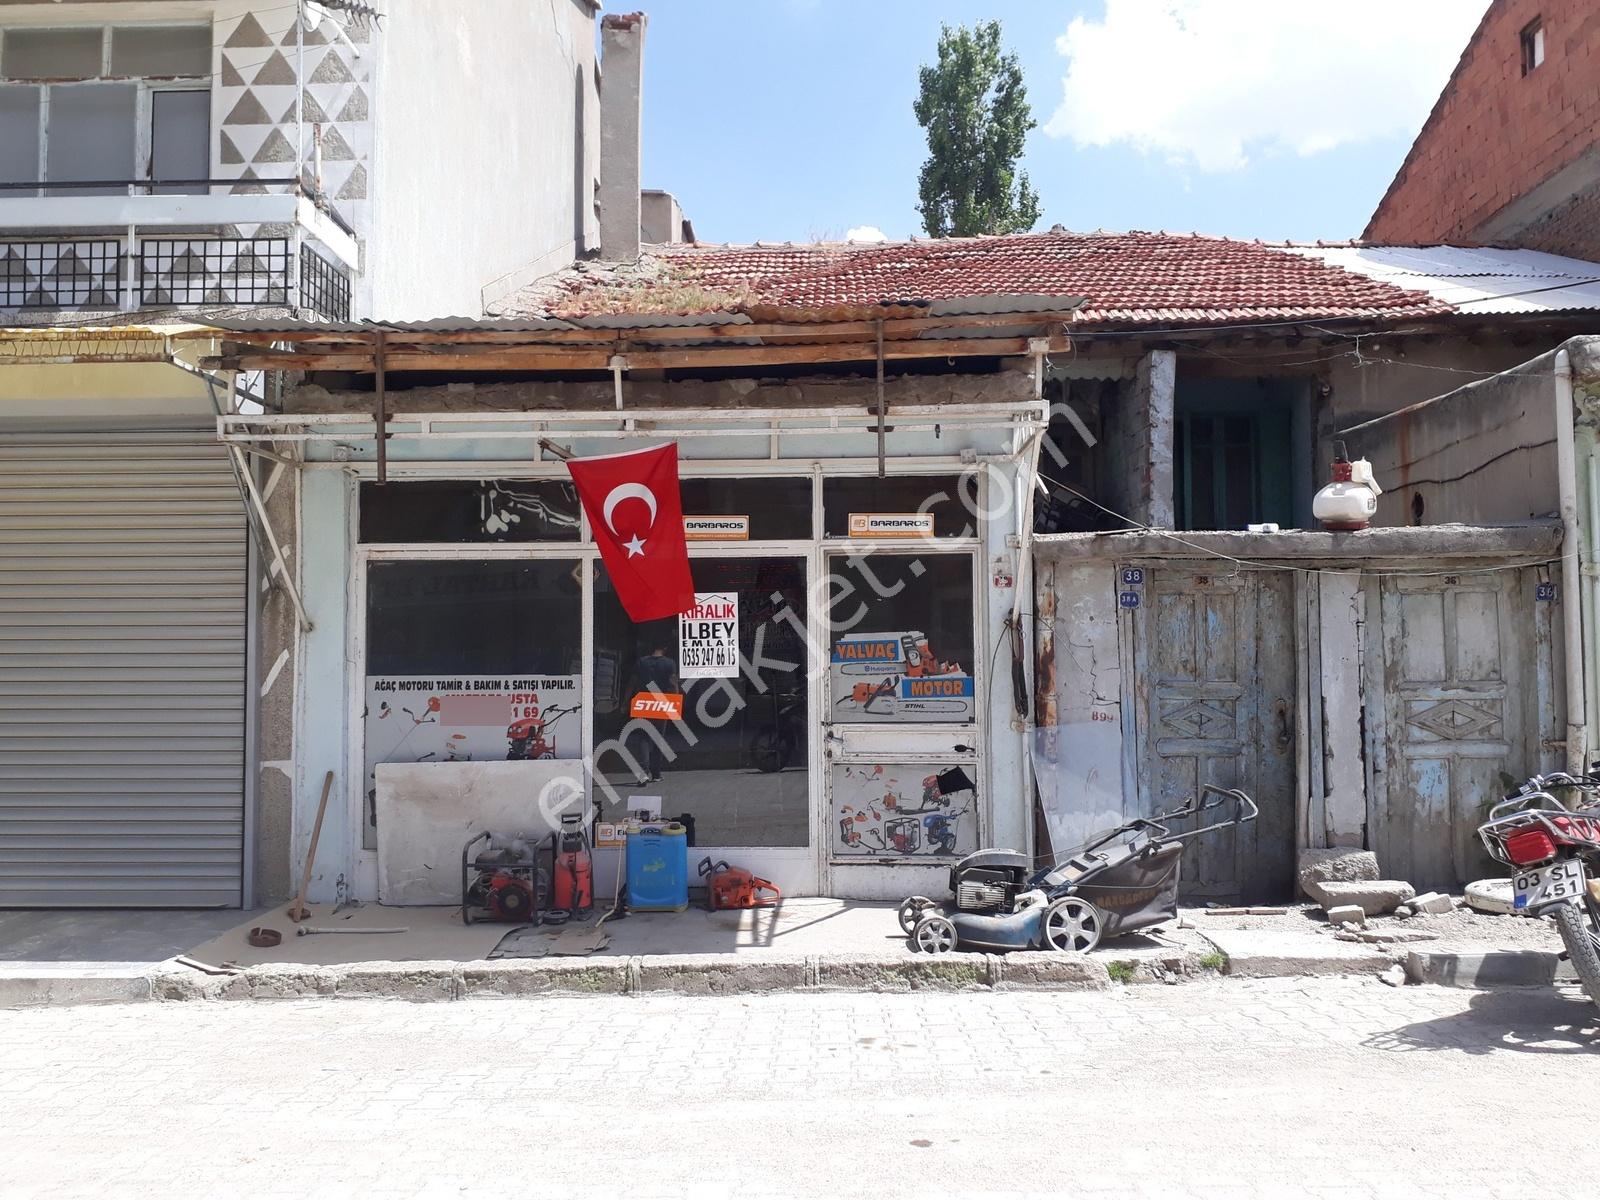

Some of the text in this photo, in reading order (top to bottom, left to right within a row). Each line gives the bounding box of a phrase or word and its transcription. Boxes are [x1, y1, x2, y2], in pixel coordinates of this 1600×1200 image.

[1126, 571, 1140, 581] 38
[1444, 576, 1457, 585] 36
[682, 620, 735, 640] İLBEY
[682, 647, 736, 666] 0535 247 66 15
[836, 642, 897, 660] YALVAÇ
[374, 678, 576, 692] AĞAÇ MOTORU TAMİR & BAKIM & SATIŞI YAPILIR.
[911, 680, 964, 696] MOTOR
[523, 706, 539, 718] 69
[633, 699, 678, 713] STIHL
[1517, 865, 1578, 890] 03 SL
[1540, 879, 1577, 898] 451
